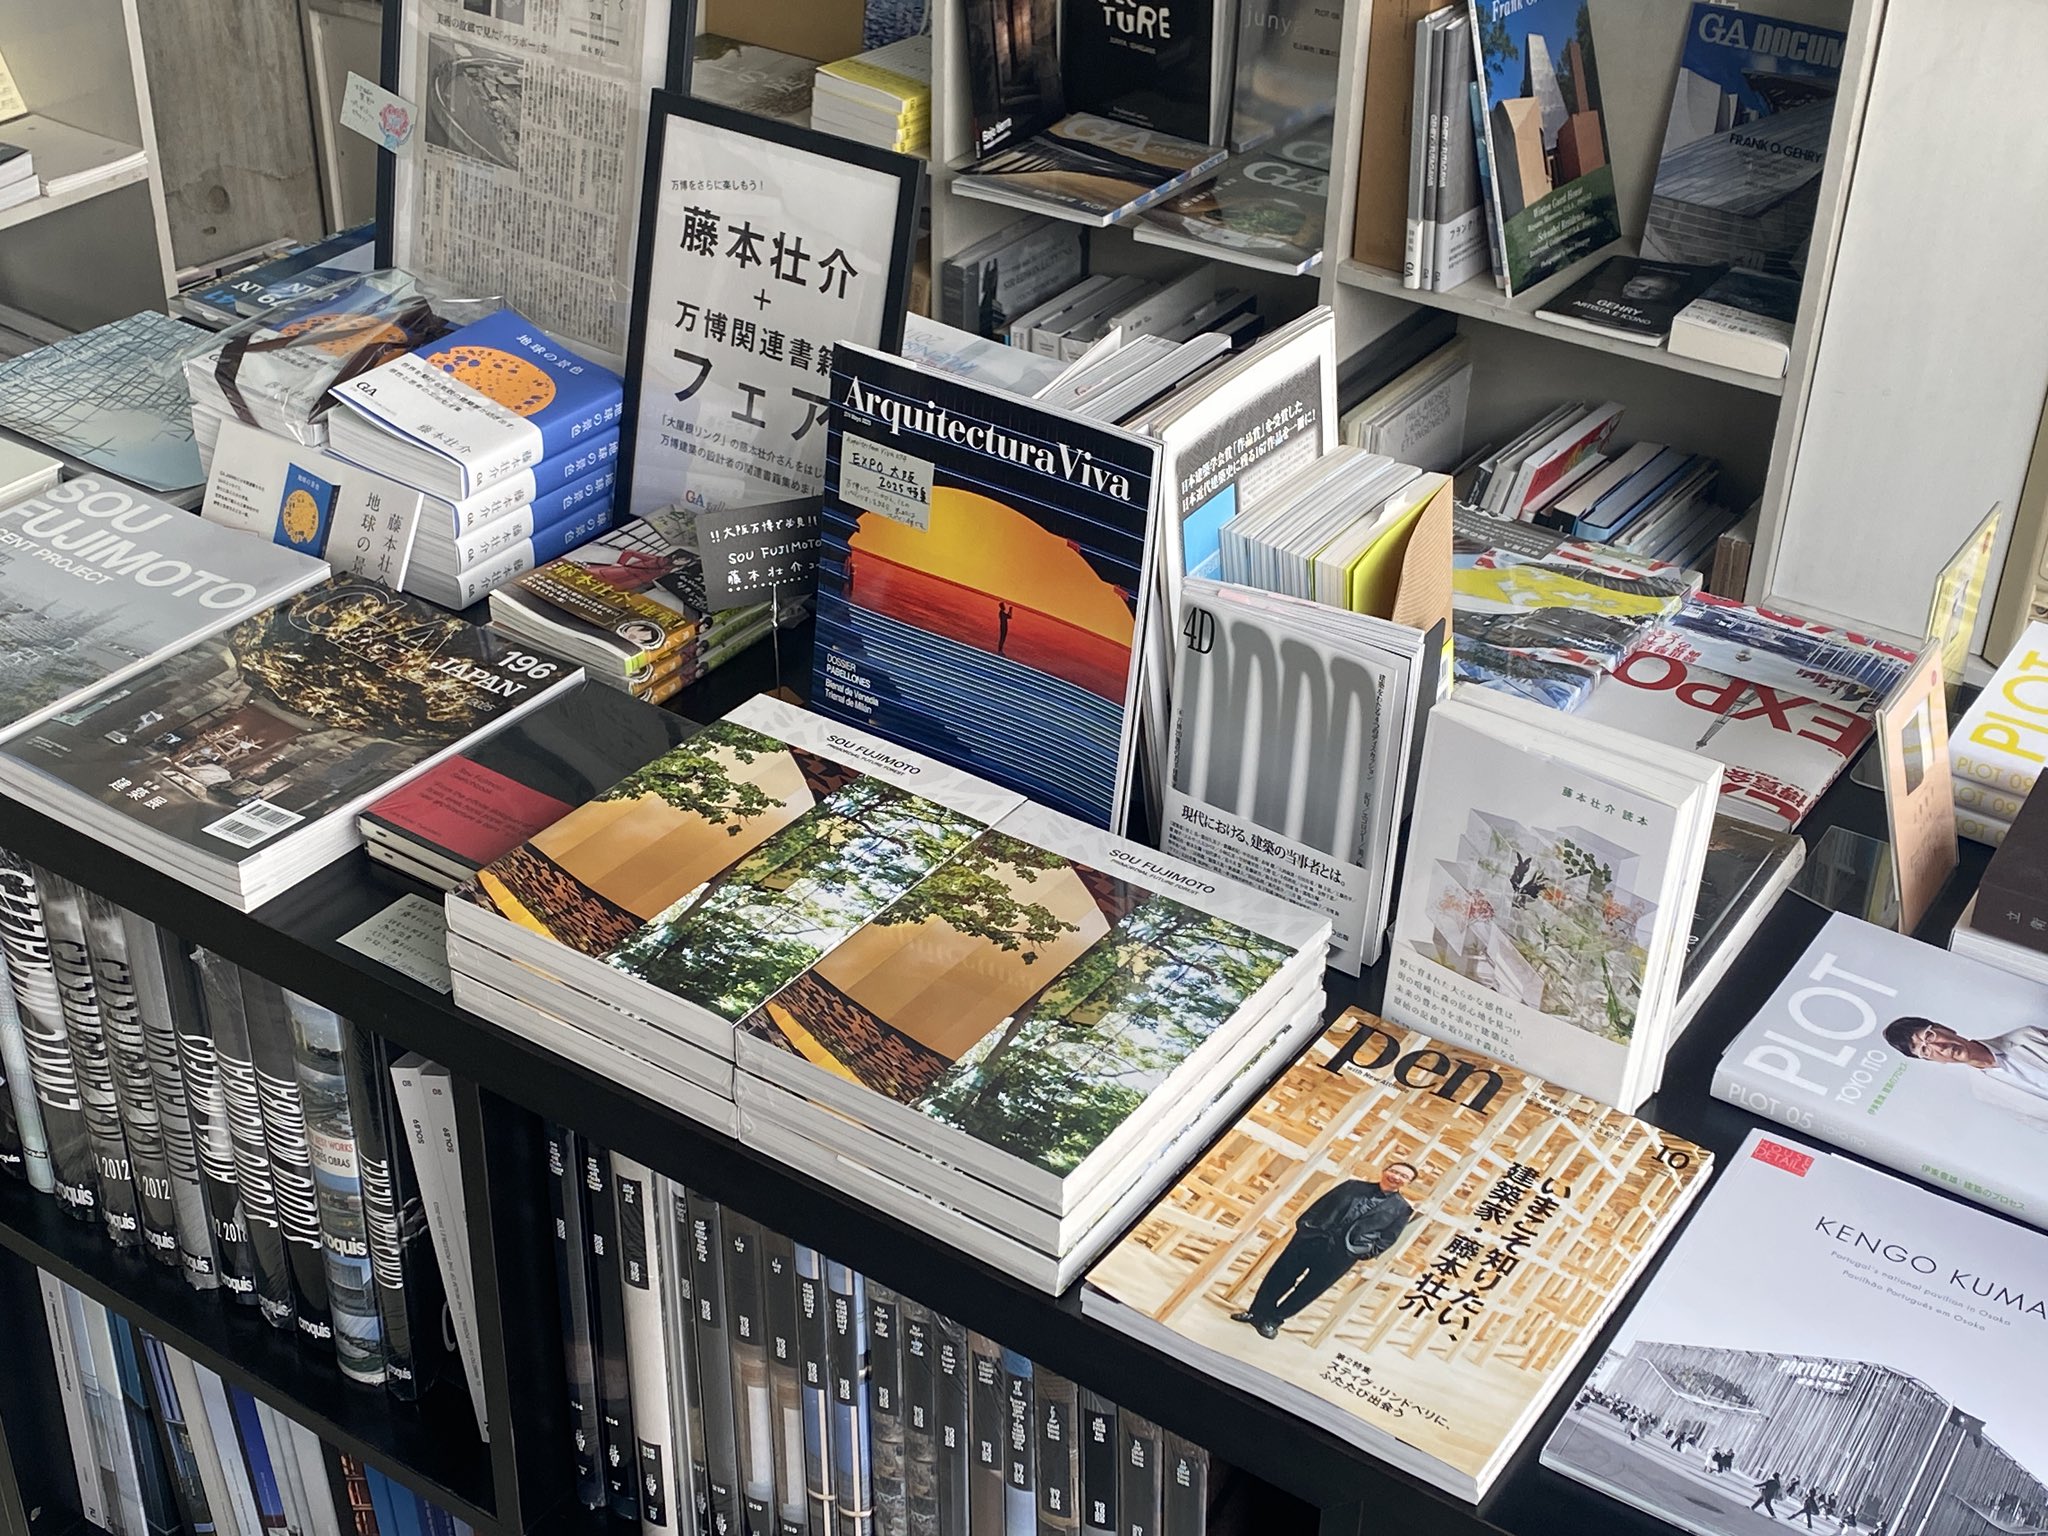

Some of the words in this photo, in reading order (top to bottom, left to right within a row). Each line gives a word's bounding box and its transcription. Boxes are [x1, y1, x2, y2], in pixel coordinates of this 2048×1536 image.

[1699, 13, 1749, 49] GA
[1062, 118, 1151, 155] GA
[1729, 133, 1768, 152] FRANK
[1783, 145, 1823, 163] GEHRY
[1243, 162, 1328, 196] GA
[680, 206, 859, 299] 藤本壮介
[1572, 300, 1613, 315] ARTISTA
[1596, 299, 1643, 315] GEHRY
[516, 334, 584, 375] 地球の景色
[356, 381, 377, 397] GA
[674, 348, 830, 441] フェア
[660, 434, 823, 497] 万博建築の設計者の関連書籍集めまし
[852, 452, 884, 474] EXPO
[46, 477, 173, 533] SOU
[686, 490, 704, 509] GA
[0, 499, 257, 609] FUJIMOTO
[32, 545, 114, 585] PROJECT
[728, 552, 755, 566] SOU
[1183, 606, 1216, 654] 4D
[430, 655, 527, 698] JAPAN
[497, 649, 557, 681] 196
[826, 664, 871, 689] PABELLONES
[827, 653, 857, 673] DOSSIER
[825, 678, 844, 694] Bienal
[845, 685, 853, 697] de
[853, 688, 879, 707] Venecia
[825, 688, 845, 705] Trienal
[845, 696, 854, 708] de
[1614, 650, 1876, 760] EXPO
[826, 735, 857, 749] SOU
[855, 745, 921, 774] FUJIMOTO
[1956, 757, 2003, 783] PLOT
[1561, 786, 1616, 815] 藤本壮介
[1621, 808, 1649, 827] 読本
[1952, 782, 1986, 808] LOT
[1181, 805, 1346, 887] 現代における、建築の当事者とは。
[1107, 849, 1143, 869] SOU
[1140, 858, 1216, 894] FUJIMOTO
[1743, 952, 1901, 1097] PLOT
[1317, 1021, 1504, 1116] pen
[1835, 1065, 1875, 1106] TOYO
[1728, 1083, 1781, 1115] PLOT
[1786, 1106, 1814, 1130] 05
[102, 1156, 131, 1181] 2012
[1651, 1143, 1689, 1171] 10
[1753, 1147, 1809, 1175] DETAILS
[1759, 1138, 1812, 1167] HOUSE
[143, 1174, 171, 1200] 2012
[1397, 1161, 1534, 1321] 建築家・藤本壮介
[1437, 1176, 1572, 1344] いまこそ知りたい、
[1815, 1216, 1937, 1275] KENGO
[1950, 1269, 2048, 1320] KUMA
[1831, 1250, 1879, 1275] Portugal's
[1882, 1272, 1922, 1292] national
[1924, 1289, 1963, 1309] pavilion
[1966, 1304, 1976, 1313] in
[1978, 1309, 2012, 1327] Osaka
[1842, 1269, 1883, 1292] Pavilhão
[1886, 1287, 1933, 1312] Português
[1936, 1309, 1950, 1318] em
[1953, 1313, 1986, 1332] Osaka
[1335, 1352, 1373, 1377] 第2特集
[1778, 1360, 1848, 1382] PORTUGAL
[1319, 1371, 1406, 1419] ふたたび出会う
[1326, 1361, 1451, 1431] スティグ・リンドベリに、
